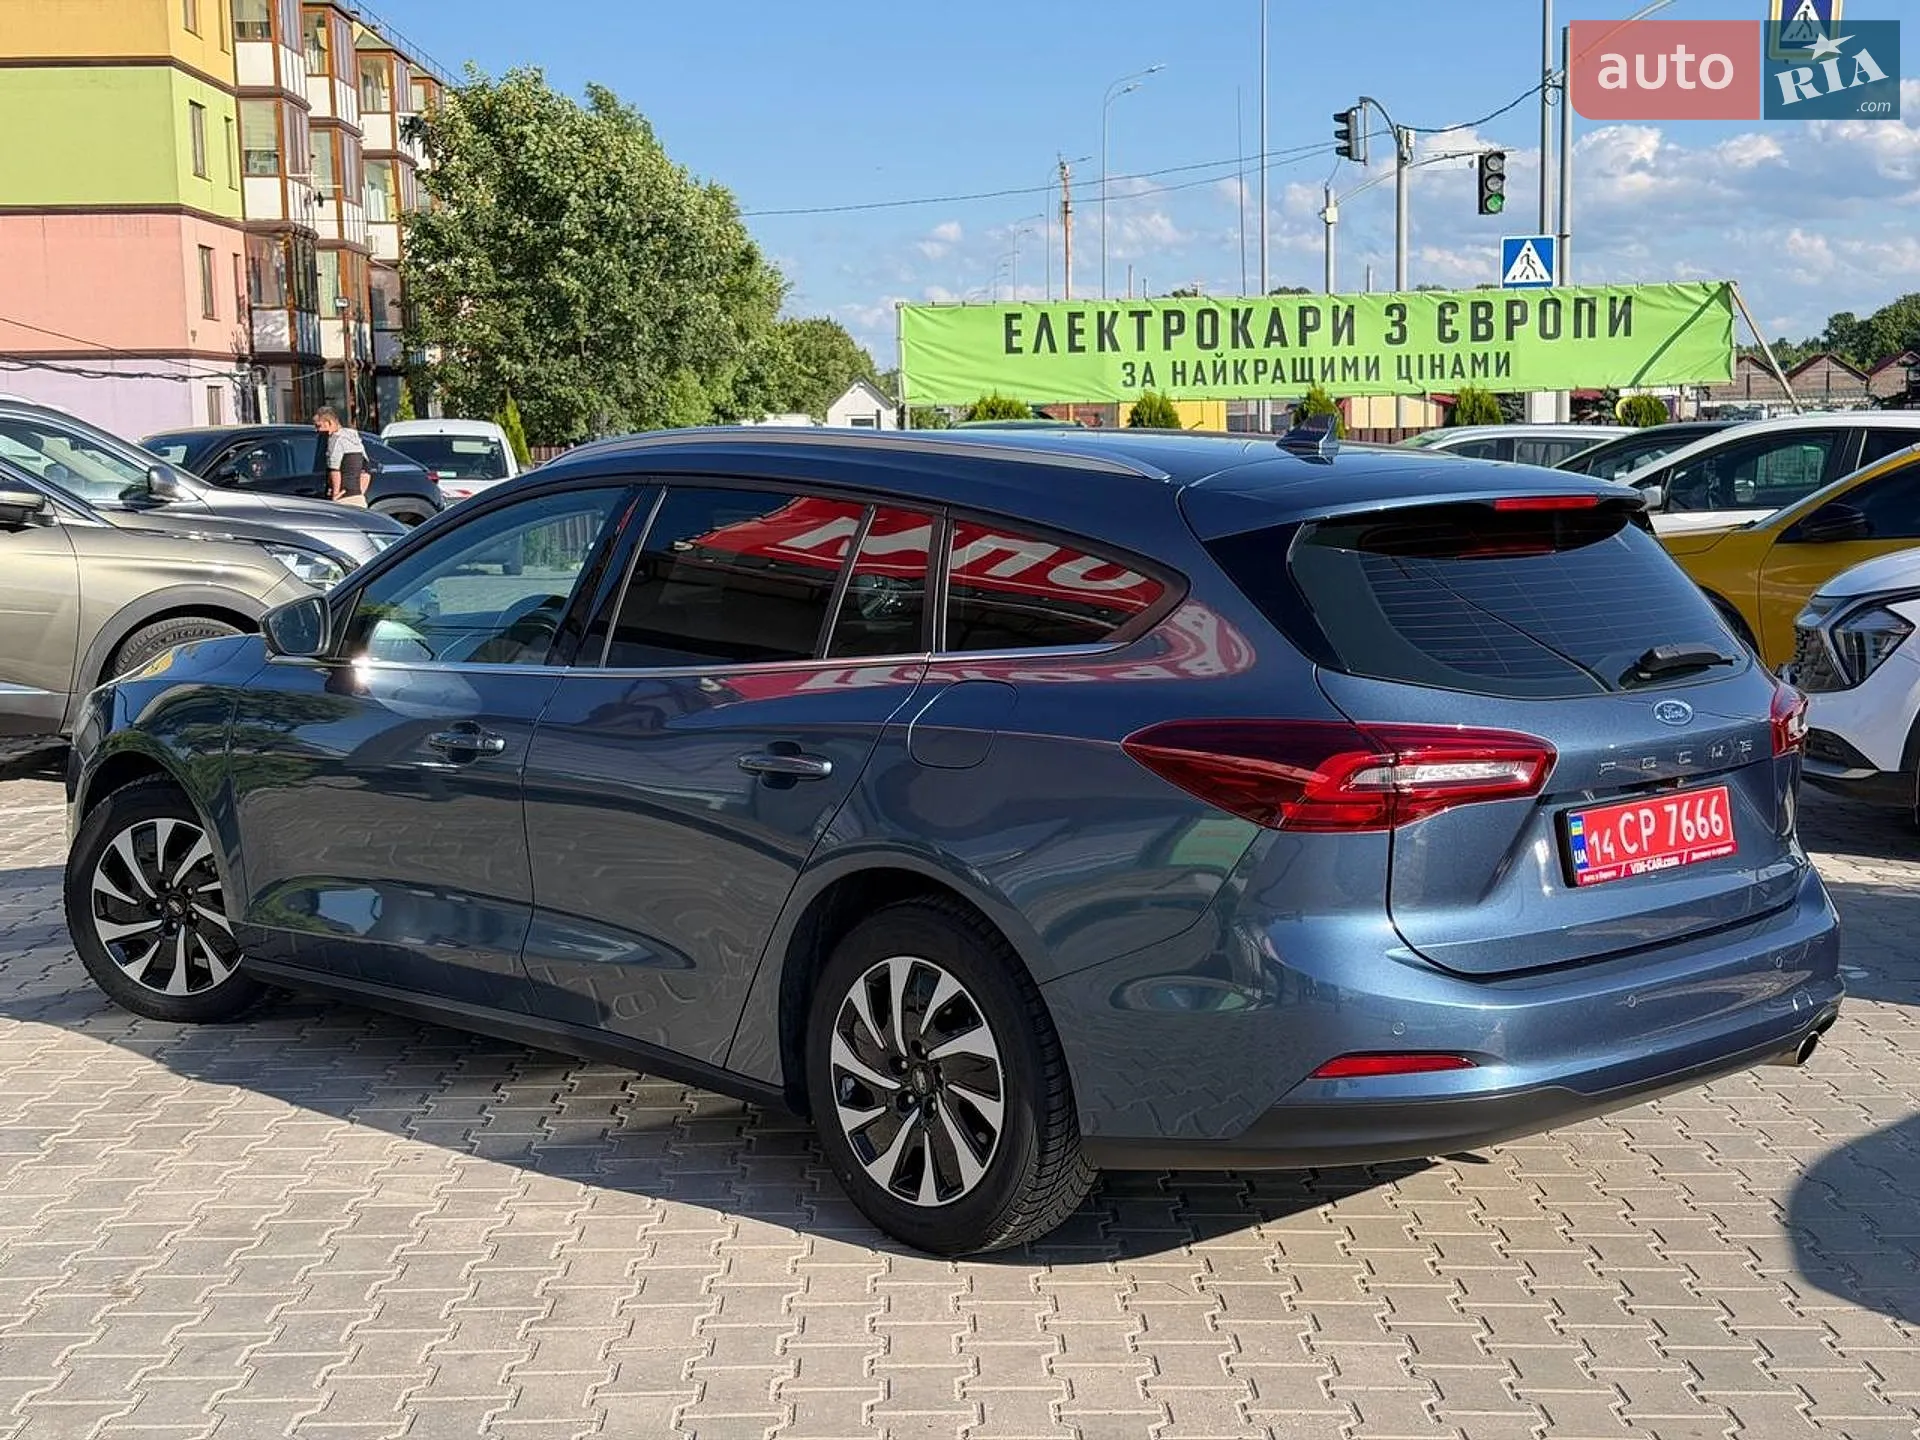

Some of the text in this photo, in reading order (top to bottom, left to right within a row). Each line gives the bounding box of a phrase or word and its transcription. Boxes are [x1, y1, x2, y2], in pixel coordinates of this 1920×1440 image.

[1004, 296, 1633, 354] ЕЛЕКТРОКАРИ З ЄВРОПИ
[1122, 351, 1511, 387] ЗА НАЙКРАЩИМИ ЦІНАМИ
[1589, 828, 1615, 862] 14
[1619, 808, 1656, 854] CP
[1664, 796, 1724, 847] 7666
[1574, 851, 1587, 864] UA
